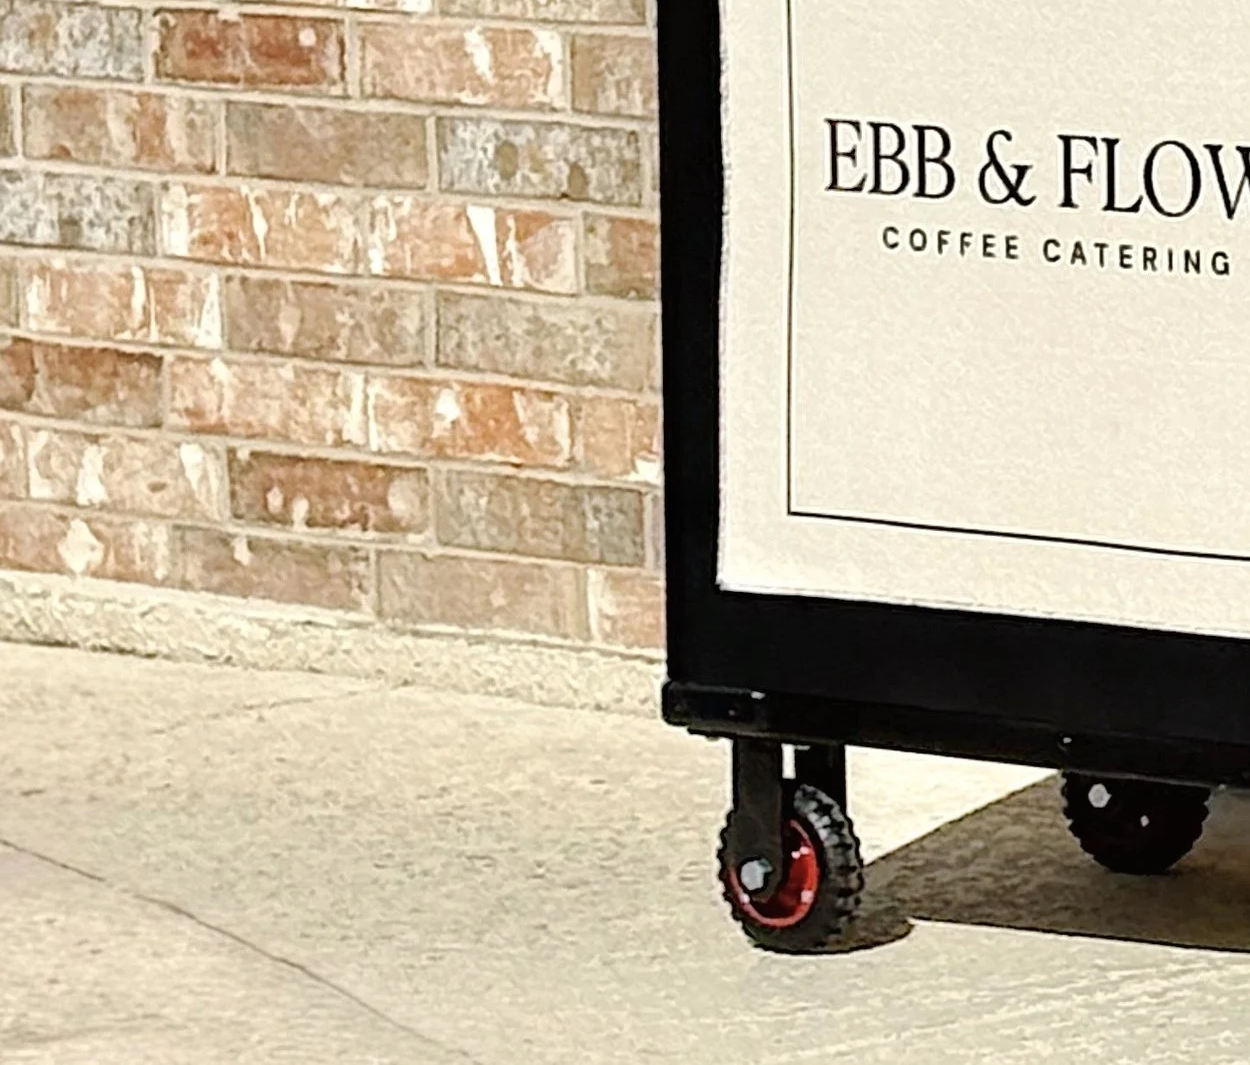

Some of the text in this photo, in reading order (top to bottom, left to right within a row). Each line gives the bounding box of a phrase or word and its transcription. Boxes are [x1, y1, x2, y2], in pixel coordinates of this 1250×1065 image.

[824, 118, 956, 199] EBB
[978, 129, 1037, 207] &
[882, 226, 1231, 276] COFFEE CATERING
